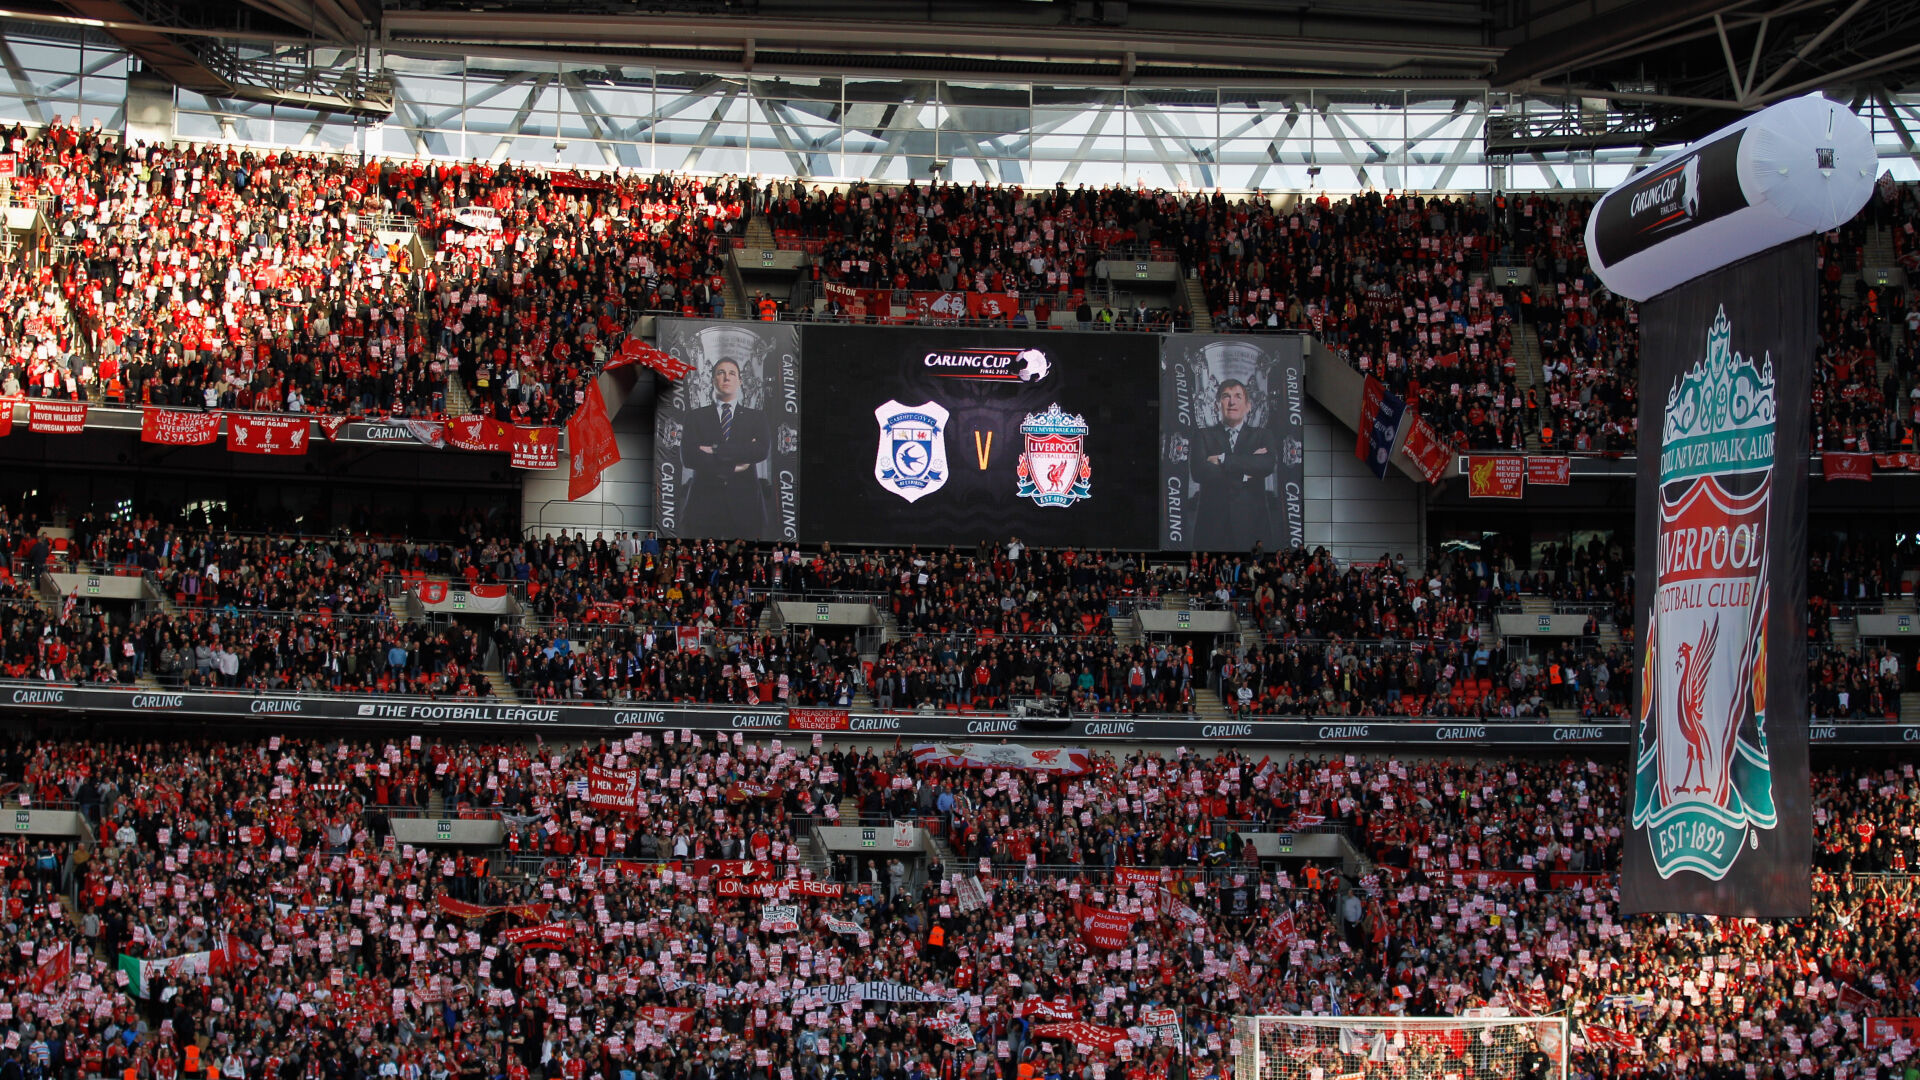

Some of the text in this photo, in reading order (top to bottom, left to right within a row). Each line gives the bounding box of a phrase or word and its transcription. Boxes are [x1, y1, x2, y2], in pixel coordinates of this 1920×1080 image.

[1630, 177, 1678, 218] CARLING CUP
[472, 208, 493, 219] KING
[825, 282, 857, 297] BILSTON
[924, 352, 1011, 368] CARLING CUP
[782, 353, 798, 414] CARLING
[1174, 363, 1191, 427] CARLING
[1286, 367, 1302, 426] CARLING
[460, 414, 485, 423] DINGLE
[155, 430, 211, 443] ASSASSIN
[974, 430, 993, 471] V
[1030, 442, 1079, 453] LIVERPOOL
[1675, 442, 1709, 471] NEVER
[1710, 437, 1747, 464] WALK
[661, 462, 675, 529] CARLING
[779, 469, 797, 539] CARLING
[1167, 476, 1182, 542] CARLING
[1285, 481, 1302, 548] CARLING
[1659, 522, 1761, 578] LIVERPOOL
[1707, 582, 1751, 608] CLUB
[817, 606, 829, 614] 213
[13, 690, 63, 703] CARLING
[131, 695, 183, 708] CARLING
[251, 700, 301, 713] CARLING
[377, 705, 560, 722] THE FOOTBALL LEAGUE
[614, 711, 665, 725] CARLING
[732, 715, 782, 728] CARLING
[799, 722, 836, 730] SILENCED
[850, 717, 900, 731] CARLING
[967, 720, 1017, 733] CARLING
[1084, 722, 1135, 735] CARLING
[1202, 724, 1251, 737] CARLING
[1318, 725, 1369, 739] CARLING
[1436, 727, 1486, 740] CARLING
[1553, 728, 1603, 741] CARLING
[1809, 727, 1836, 740] LING
[597, 780, 611, 790] MEN
[615, 783, 625, 792] AT
[17, 814, 29, 822] 109
[438, 823, 450, 831] 110
[863, 831, 875, 839] 111
[719, 880, 750, 895] LONG
[783, 879, 800, 891] HE
[804, 880, 841, 895] REIGN
